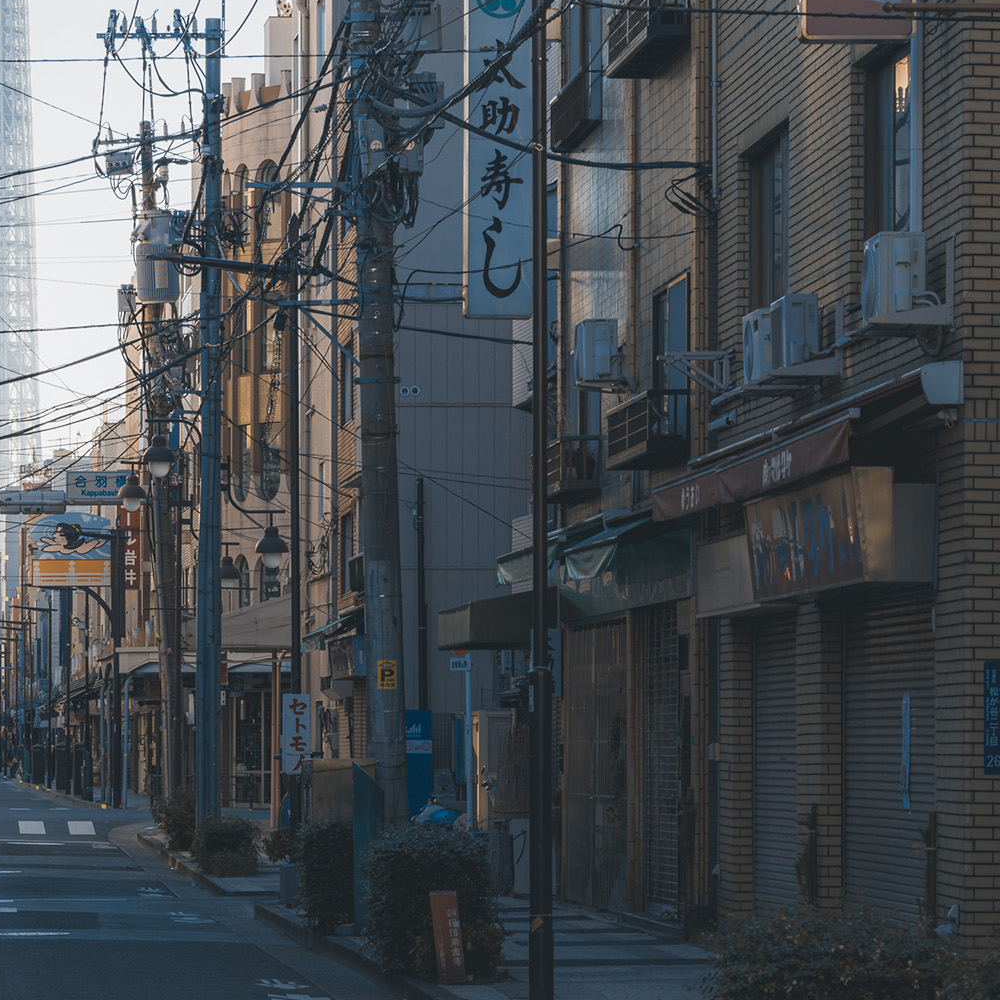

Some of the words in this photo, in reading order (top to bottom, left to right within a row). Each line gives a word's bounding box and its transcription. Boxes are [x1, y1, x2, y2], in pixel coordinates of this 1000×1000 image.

[475, 39, 527, 299] 太助寿し
[81, 489, 118, 498] Kappabash
[381, 669, 394, 681] P
[289, 698, 307, 771] セトモノ
